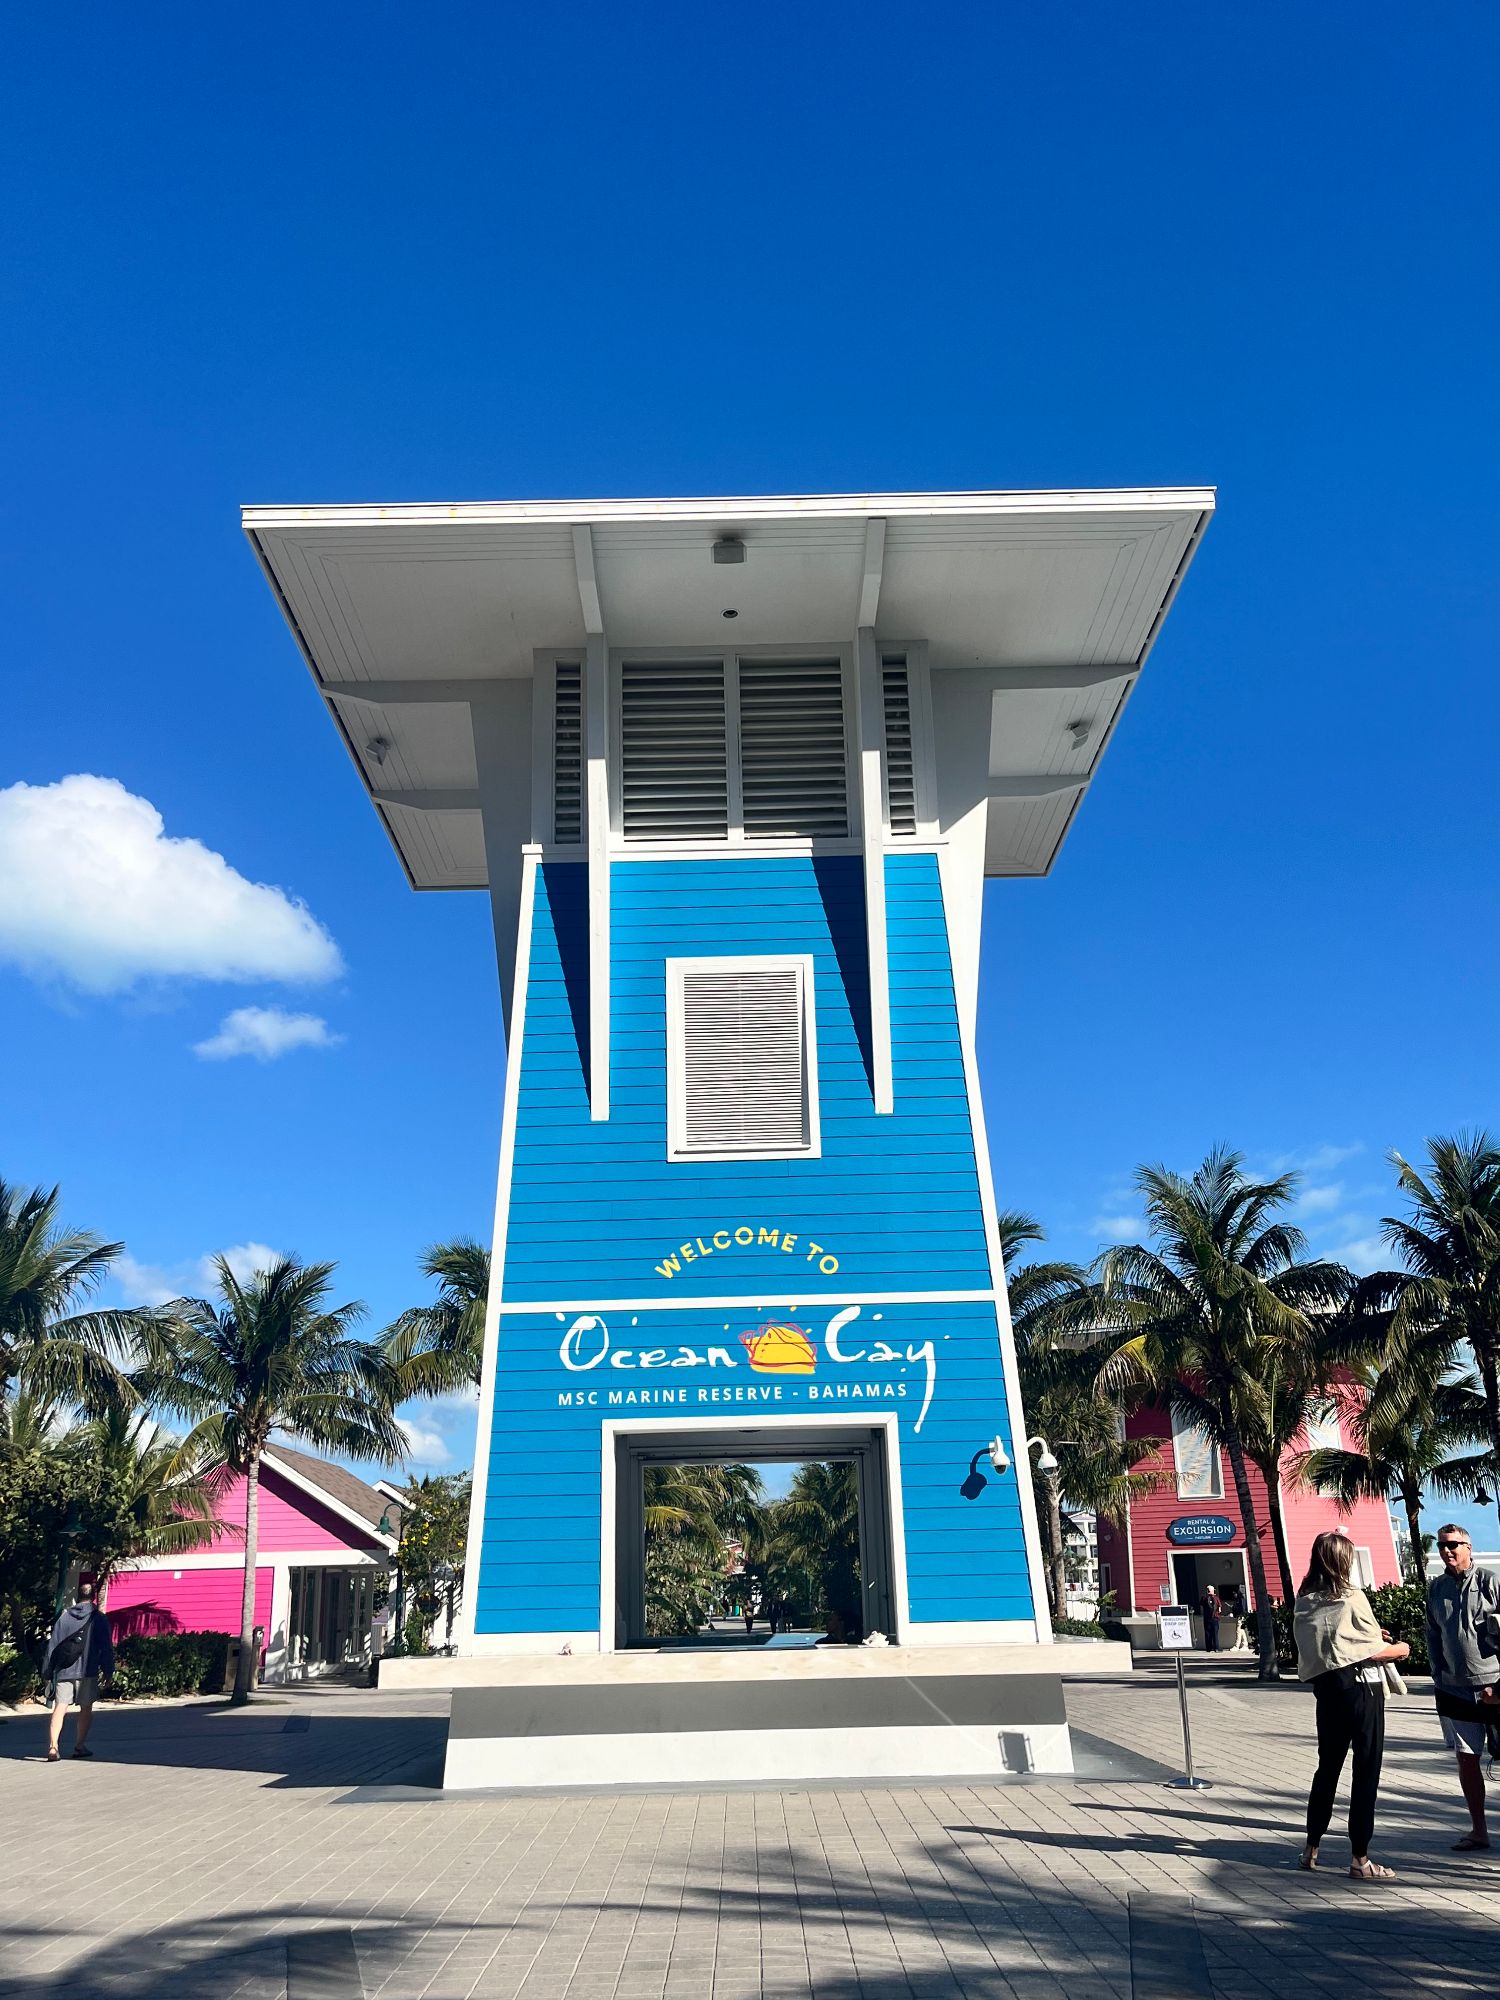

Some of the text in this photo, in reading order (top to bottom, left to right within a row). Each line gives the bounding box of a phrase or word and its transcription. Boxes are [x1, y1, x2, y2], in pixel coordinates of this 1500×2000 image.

[654, 1226, 839, 1279] WELCOME TO
[559, 1305, 936, 1434] Ocean Cay
[558, 1391, 598, 1406] MSC
[608, 1389, 687, 1404] MARINE
[698, 1386, 782, 1402] RESERVE
[808, 1383, 907, 1399] BAHAMAS
[1173, 1525, 1231, 1536] EXCURSION
